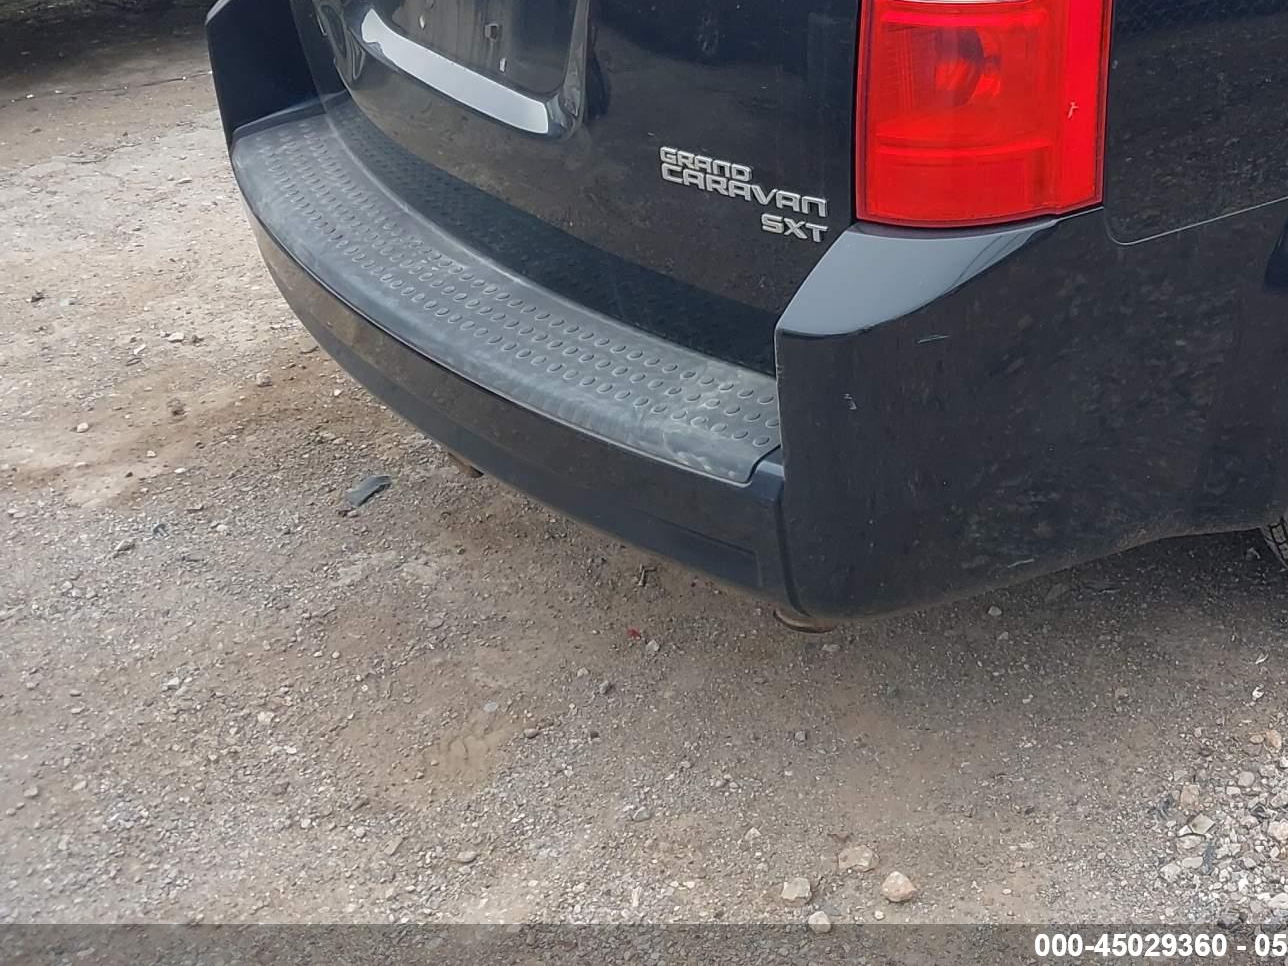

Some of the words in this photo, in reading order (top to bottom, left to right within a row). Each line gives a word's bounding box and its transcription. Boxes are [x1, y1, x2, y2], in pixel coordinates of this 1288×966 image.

[660, 146, 752, 182] GRAND
[661, 162, 828, 218] CARAVAN
[761, 212, 829, 243] SXT
